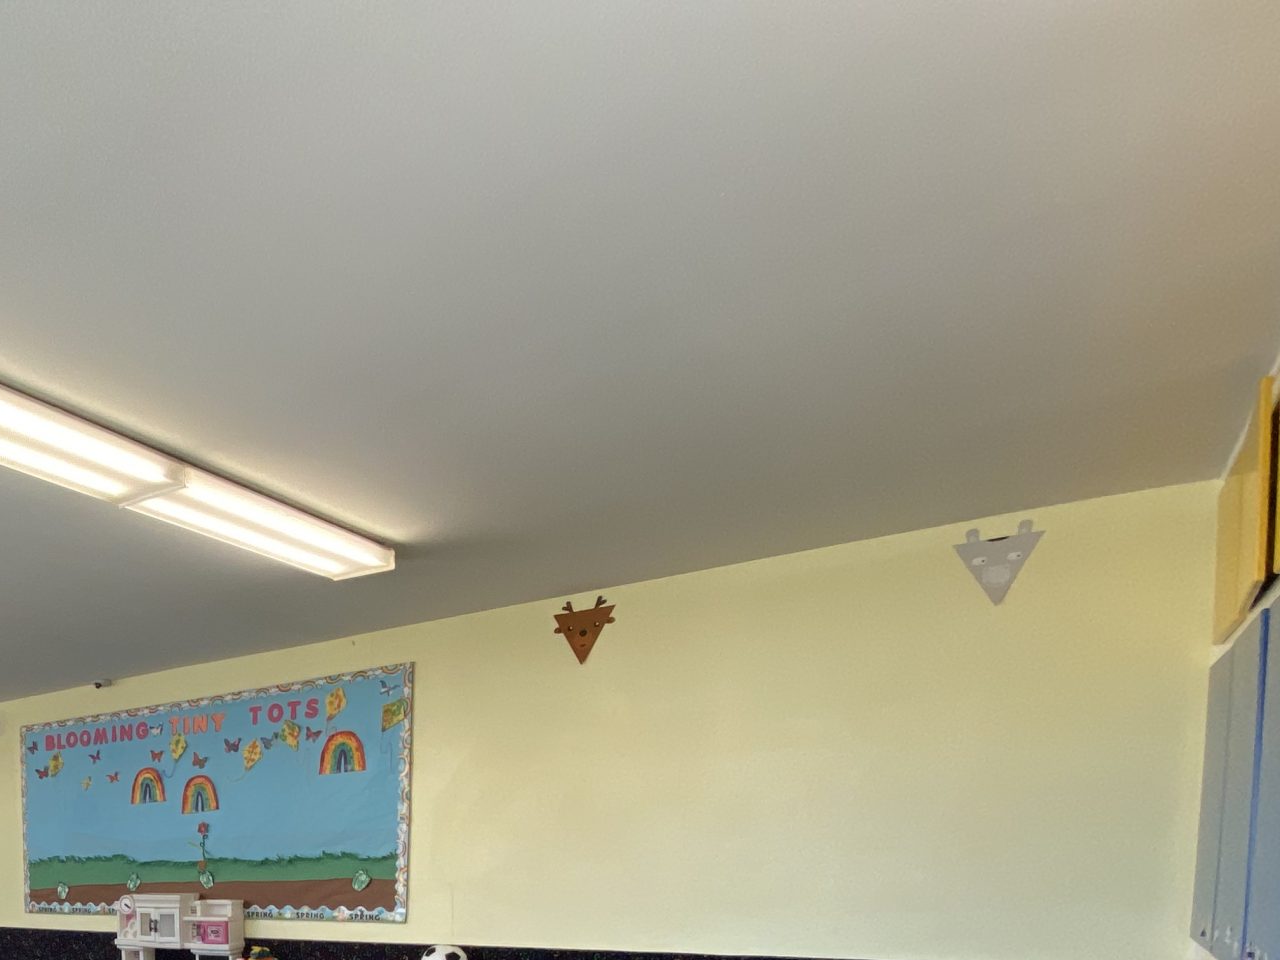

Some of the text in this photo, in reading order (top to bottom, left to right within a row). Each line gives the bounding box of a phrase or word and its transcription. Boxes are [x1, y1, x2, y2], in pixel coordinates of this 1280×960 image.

[45, 698, 320, 751] BLOOMING TINY TOTS
[246, 911, 273, 919] SPRING
[296, 912, 324, 920] SPRING
[349, 912, 381, 921] SPRING
